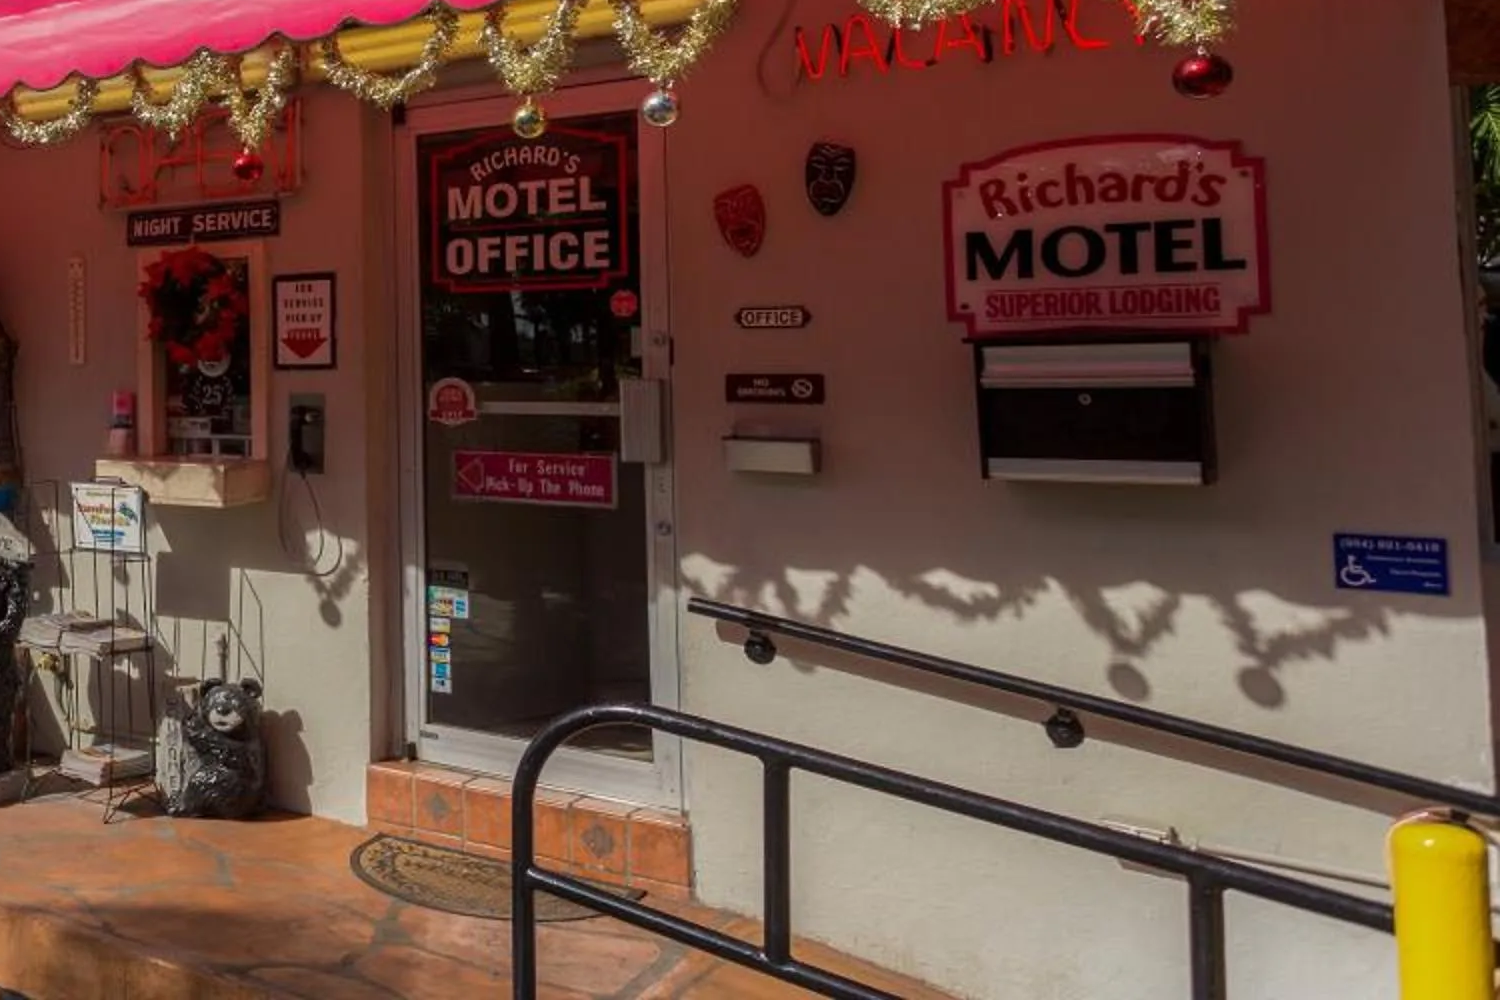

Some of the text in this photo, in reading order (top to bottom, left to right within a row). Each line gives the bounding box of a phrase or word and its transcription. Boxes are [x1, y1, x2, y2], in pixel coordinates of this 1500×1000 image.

[470, 145, 581, 182] RICHARD'S
[447, 176, 607, 221] MOTEL
[979, 159, 1227, 220] Richard's
[133, 208, 273, 238] NIGHT SERVICE
[445, 230, 610, 275] OFFICE
[965, 217, 1247, 281] MOTEL
[745, 311, 800, 325] OFFICE
[985, 286, 1221, 319] SUPERIOR LODGING
[508, 458, 585, 476] For Service
[540, 478, 561, 494] The
[568, 480, 605, 497] Phone
